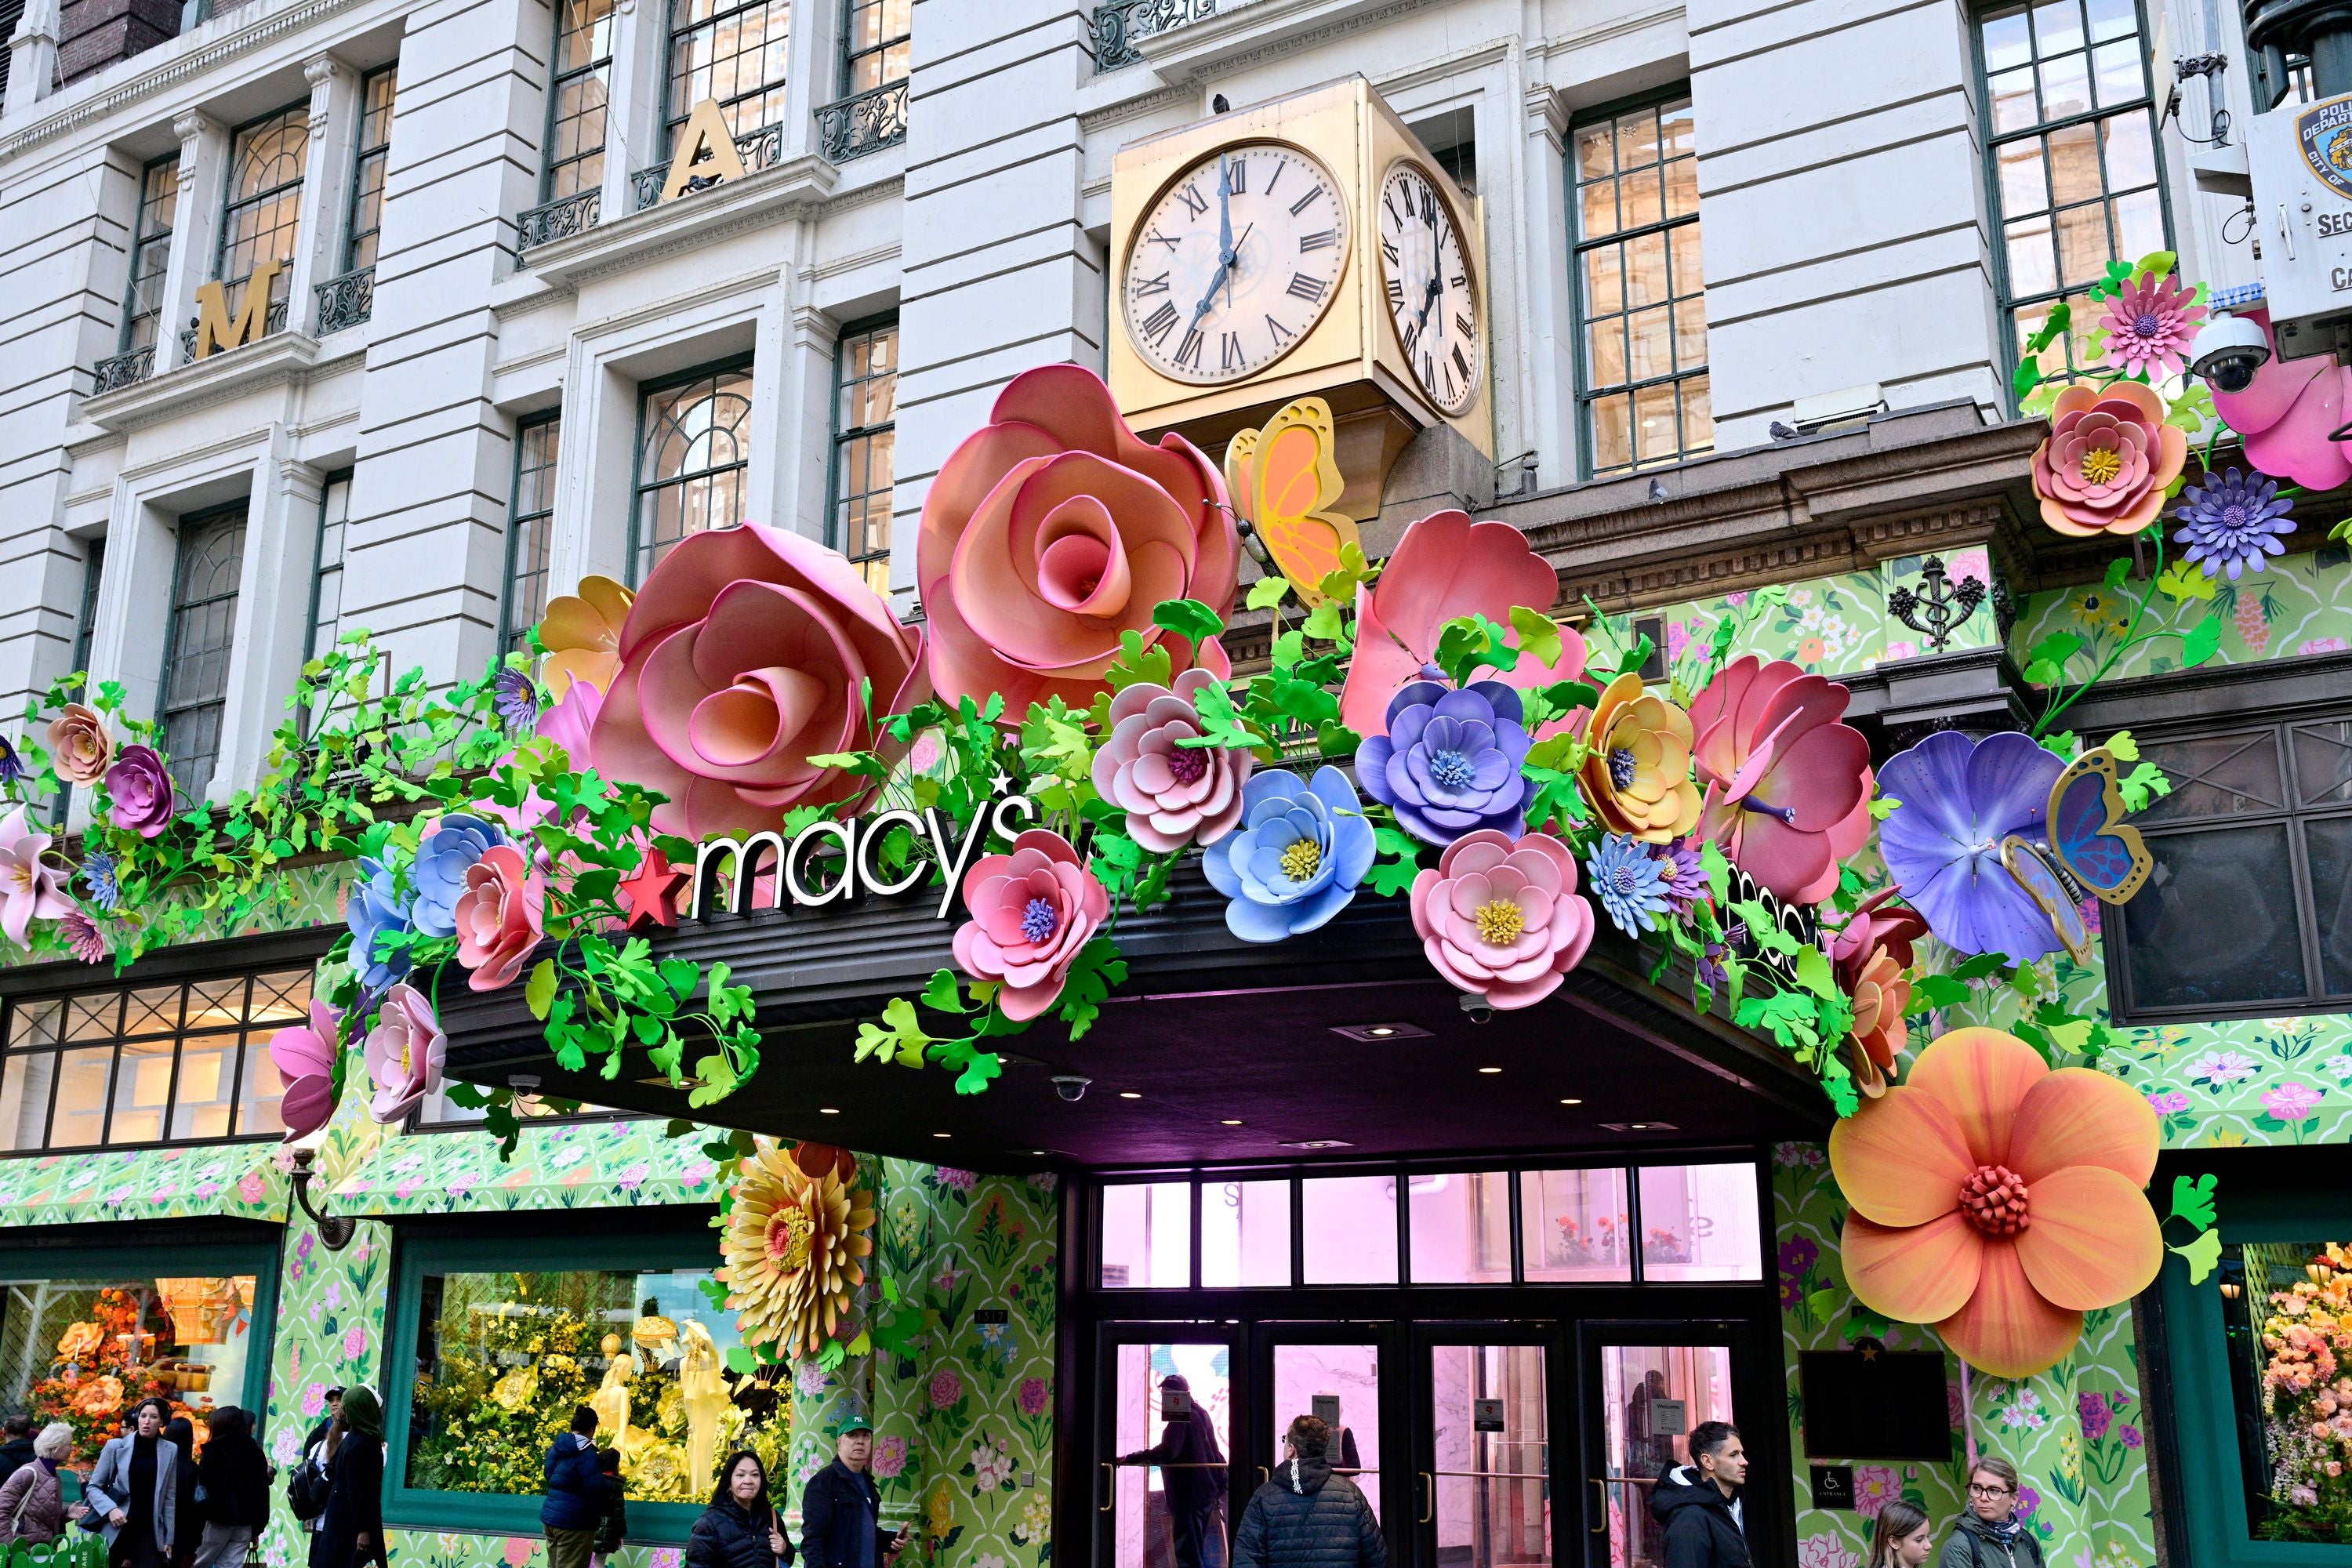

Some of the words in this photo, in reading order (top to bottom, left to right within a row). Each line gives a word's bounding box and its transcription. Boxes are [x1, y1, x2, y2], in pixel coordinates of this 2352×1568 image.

[657, 97, 746, 204] A
[2307, 151, 2329, 173] CITY
[2327, 174, 2345, 187] OF
[194, 257, 283, 361] M
[2211, 283, 2262, 310] NYPD
